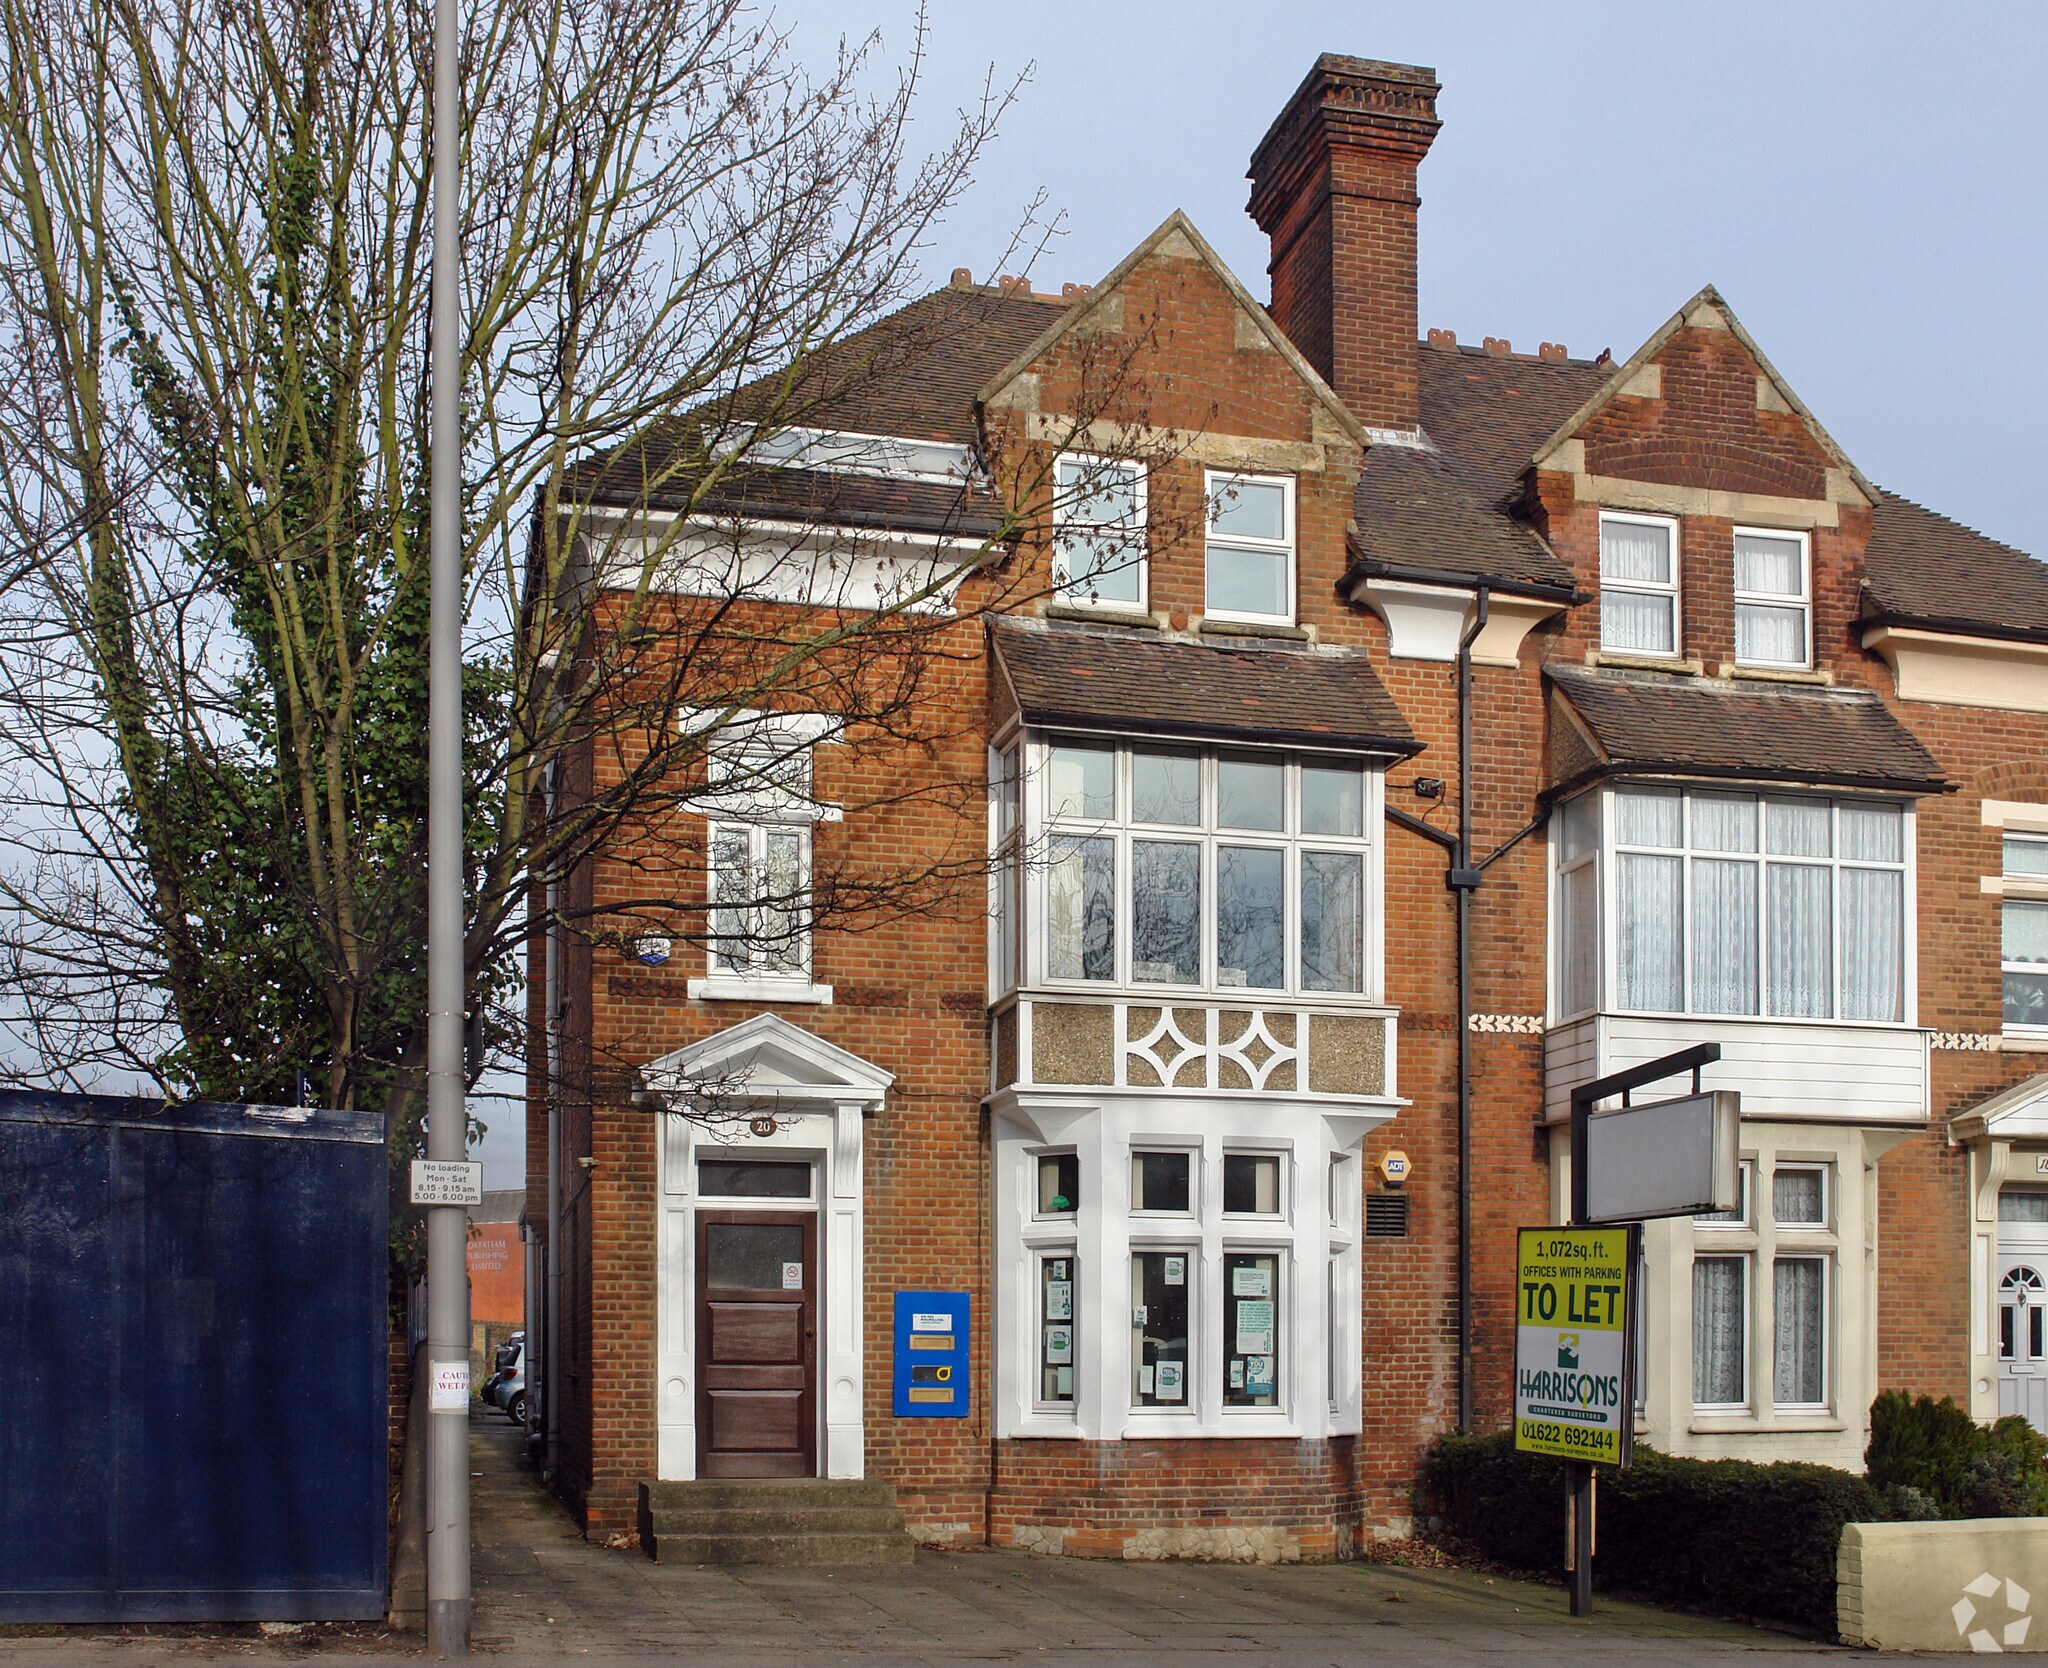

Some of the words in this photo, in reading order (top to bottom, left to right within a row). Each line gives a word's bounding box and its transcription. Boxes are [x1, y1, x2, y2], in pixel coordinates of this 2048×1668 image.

[757, 1120, 771, 1132] 20
[438, 1164, 470, 1173] loading
[1388, 1162, 1404, 1171] ADT
[426, 1174, 445, 1182] Mon
[451, 1175, 467, 1183] Sat
[442, 1184, 461, 1192] 9.15
[415, 1192, 436, 1200] 5.00
[442, 1193, 464, 1201] 6.00
[1536, 1240, 1609, 1261] 1,072sq.ft.
[467, 1251, 509, 1260] UBLISHING
[471, 1262, 502, 1271] LIMITED
[1523, 1265, 1557, 1278] OFFICES
[1560, 1266, 1582, 1279] WITH
[1584, 1267, 1622, 1280] PARKING
[1523, 1282, 1557, 1321] TO
[1568, 1284, 1621, 1325] LET
[438, 1382, 461, 1390] WET
[1520, 1369, 1618, 1407] HARRISONS
[1533, 1406, 1565, 1417] CHARTERED
[1567, 1411, 1601, 1420] SURVEYORS
[1522, 1421, 1560, 1443] 01622
[1565, 1427, 1613, 1450] 692144
